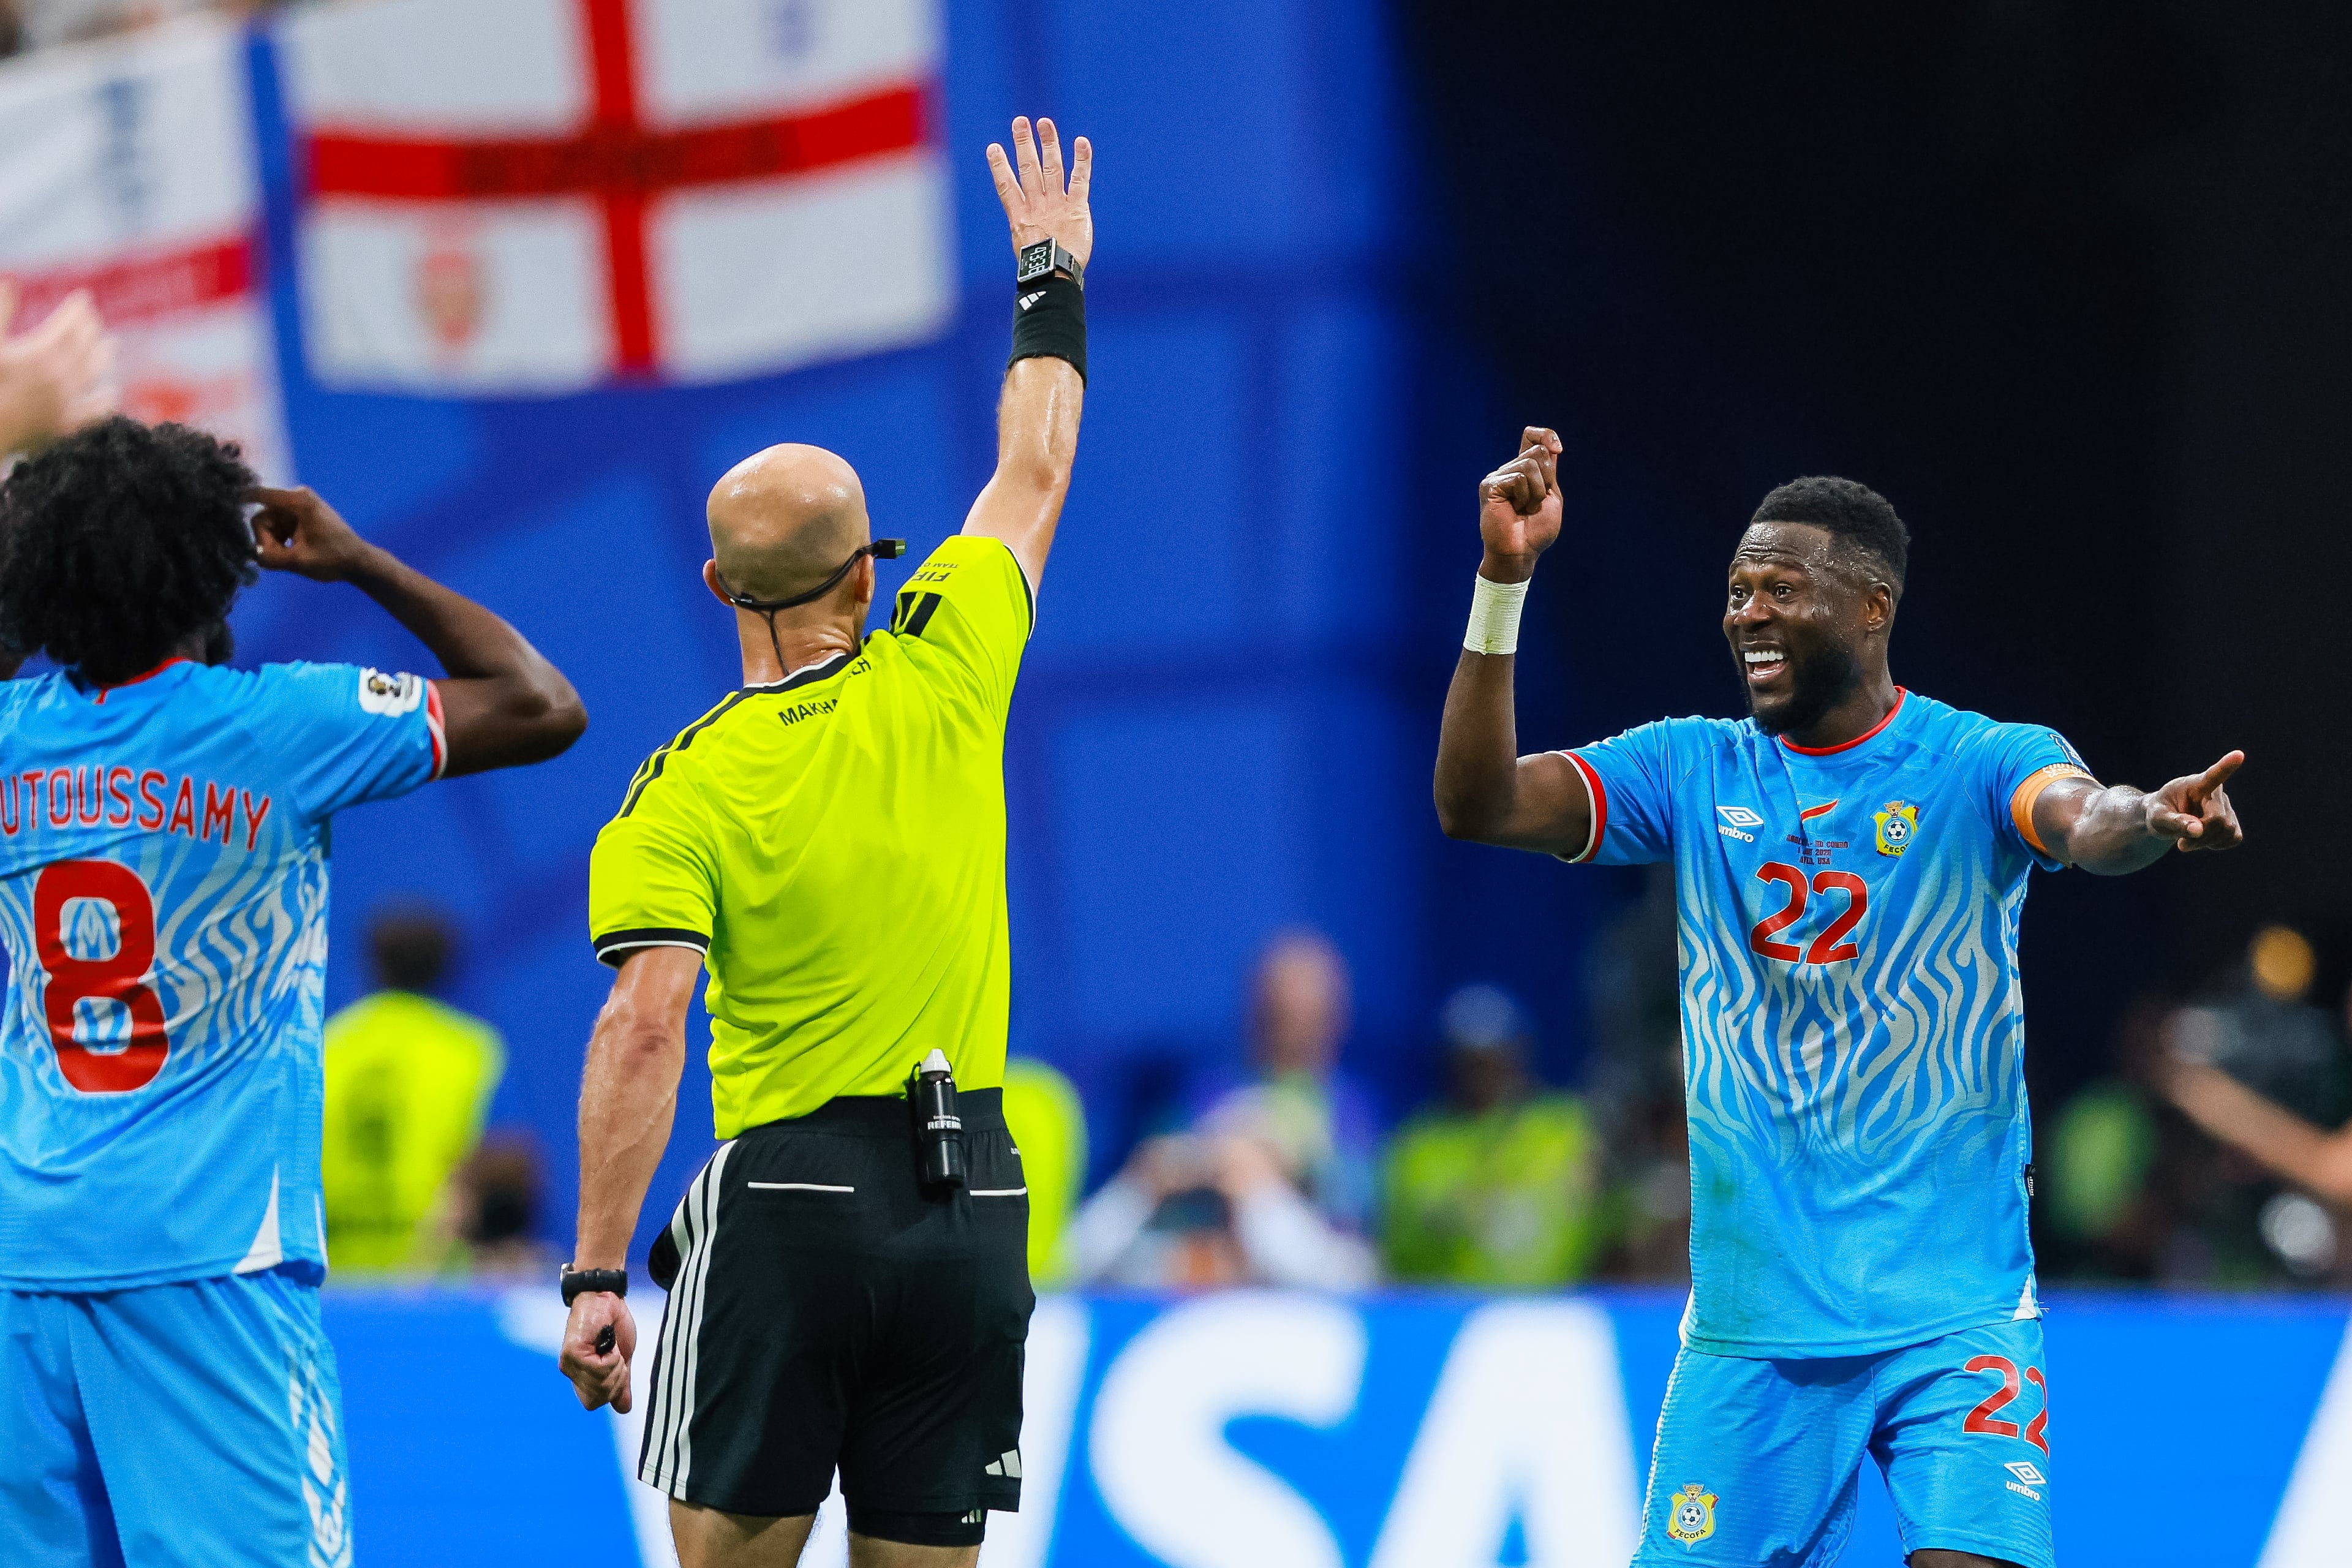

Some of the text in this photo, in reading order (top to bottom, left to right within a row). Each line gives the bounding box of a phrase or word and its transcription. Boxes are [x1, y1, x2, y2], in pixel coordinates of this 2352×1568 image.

[911, 571, 951, 582] FIF
[0, 766, 271, 851] UTOUSSAMY
[1717, 823, 1755, 843] umbro
[1751, 862, 1868, 965] 22
[33, 859, 170, 1094] 8
[2005, 1480, 2041, 1502] umbro
[1675, 1528, 1706, 1539] FECOFA
